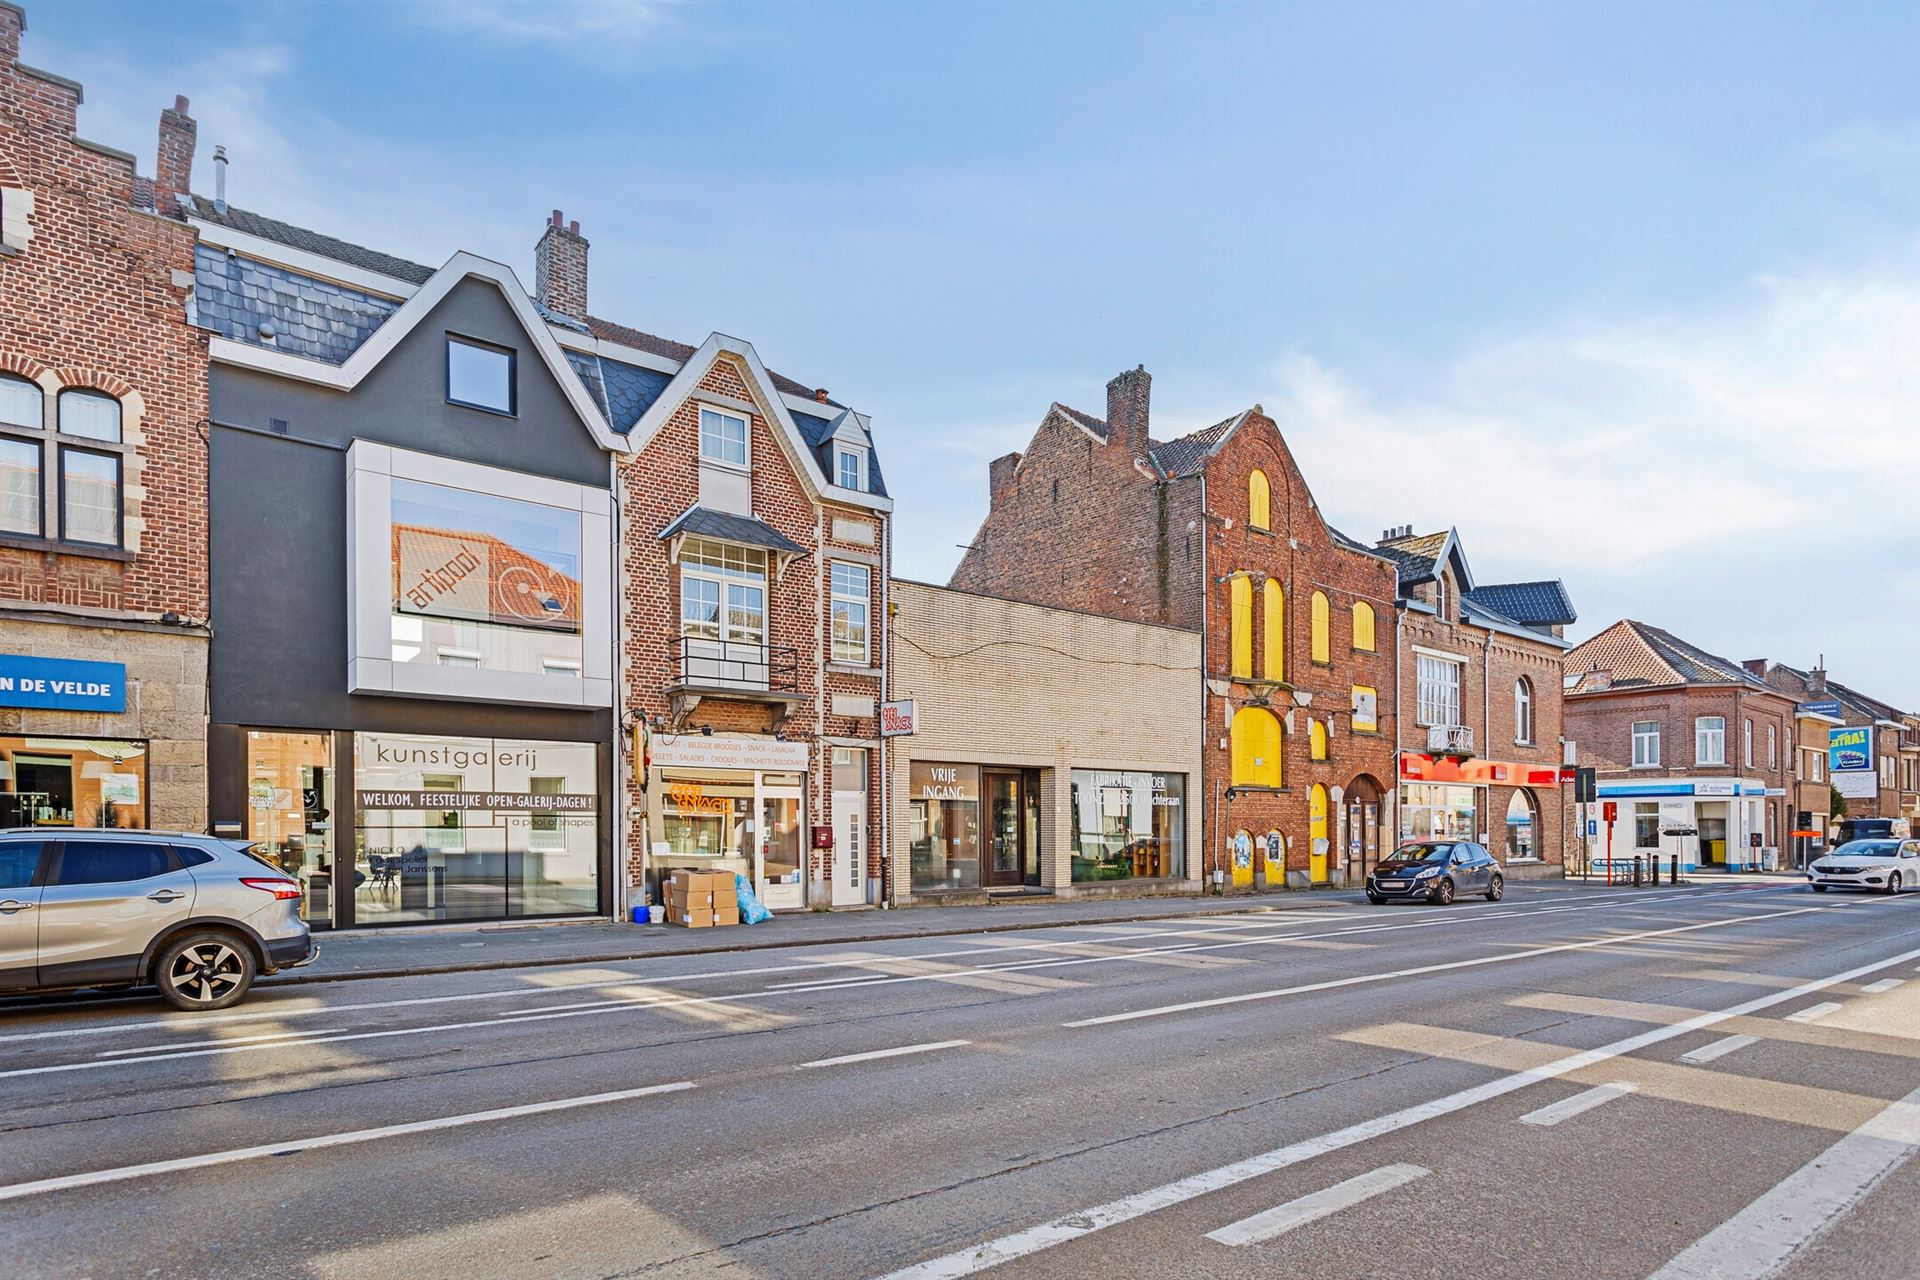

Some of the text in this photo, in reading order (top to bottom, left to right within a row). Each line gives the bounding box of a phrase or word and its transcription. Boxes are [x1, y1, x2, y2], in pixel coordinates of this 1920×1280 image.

[20, 678, 46, 692] DE
[50, 680, 111, 697] VELDE
[886, 716, 912, 731] SNACK
[679, 754, 705, 762] SALADES
[711, 755, 738, 764] CROQUES
[930, 767, 957, 784] VRIJE
[1090, 774, 1166, 789] FABRIKATIE INVOER
[922, 785, 965, 800] INGANG
[362, 793, 414, 807] WELKOM,
[420, 794, 481, 809] FEESTELIJKE
[512, 819, 520, 827] a
[522, 818, 546, 828] pool
